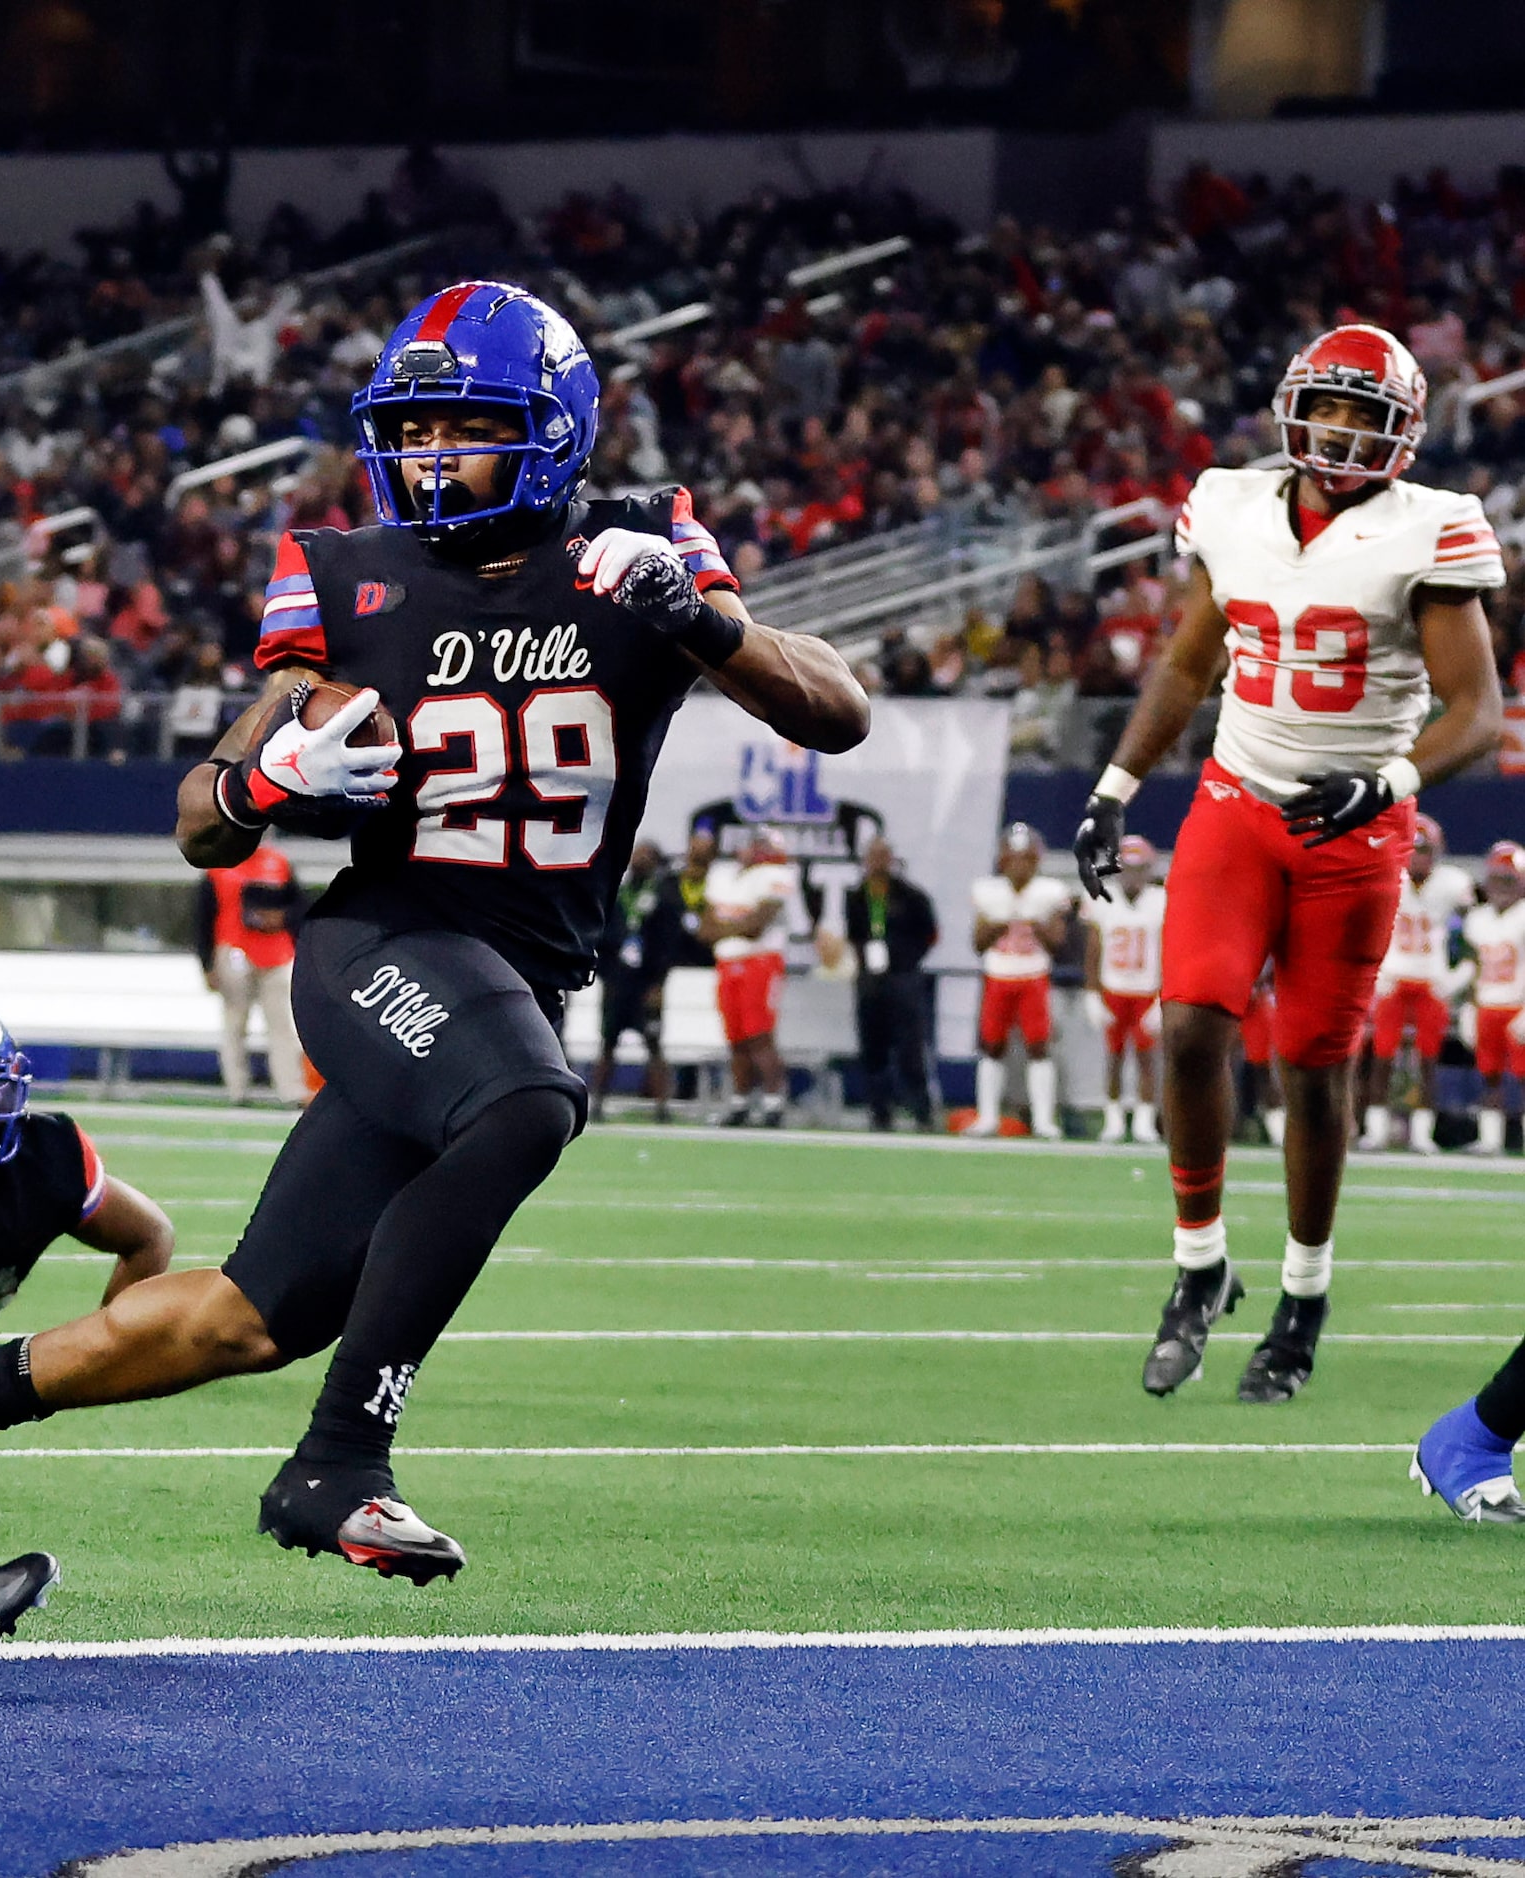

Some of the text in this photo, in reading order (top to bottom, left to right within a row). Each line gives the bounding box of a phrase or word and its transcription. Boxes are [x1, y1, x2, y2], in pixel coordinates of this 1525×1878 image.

[427, 623, 591, 686] D'Ville
[408, 684, 618, 870] 29
[351, 964, 450, 1058] D'Ville
